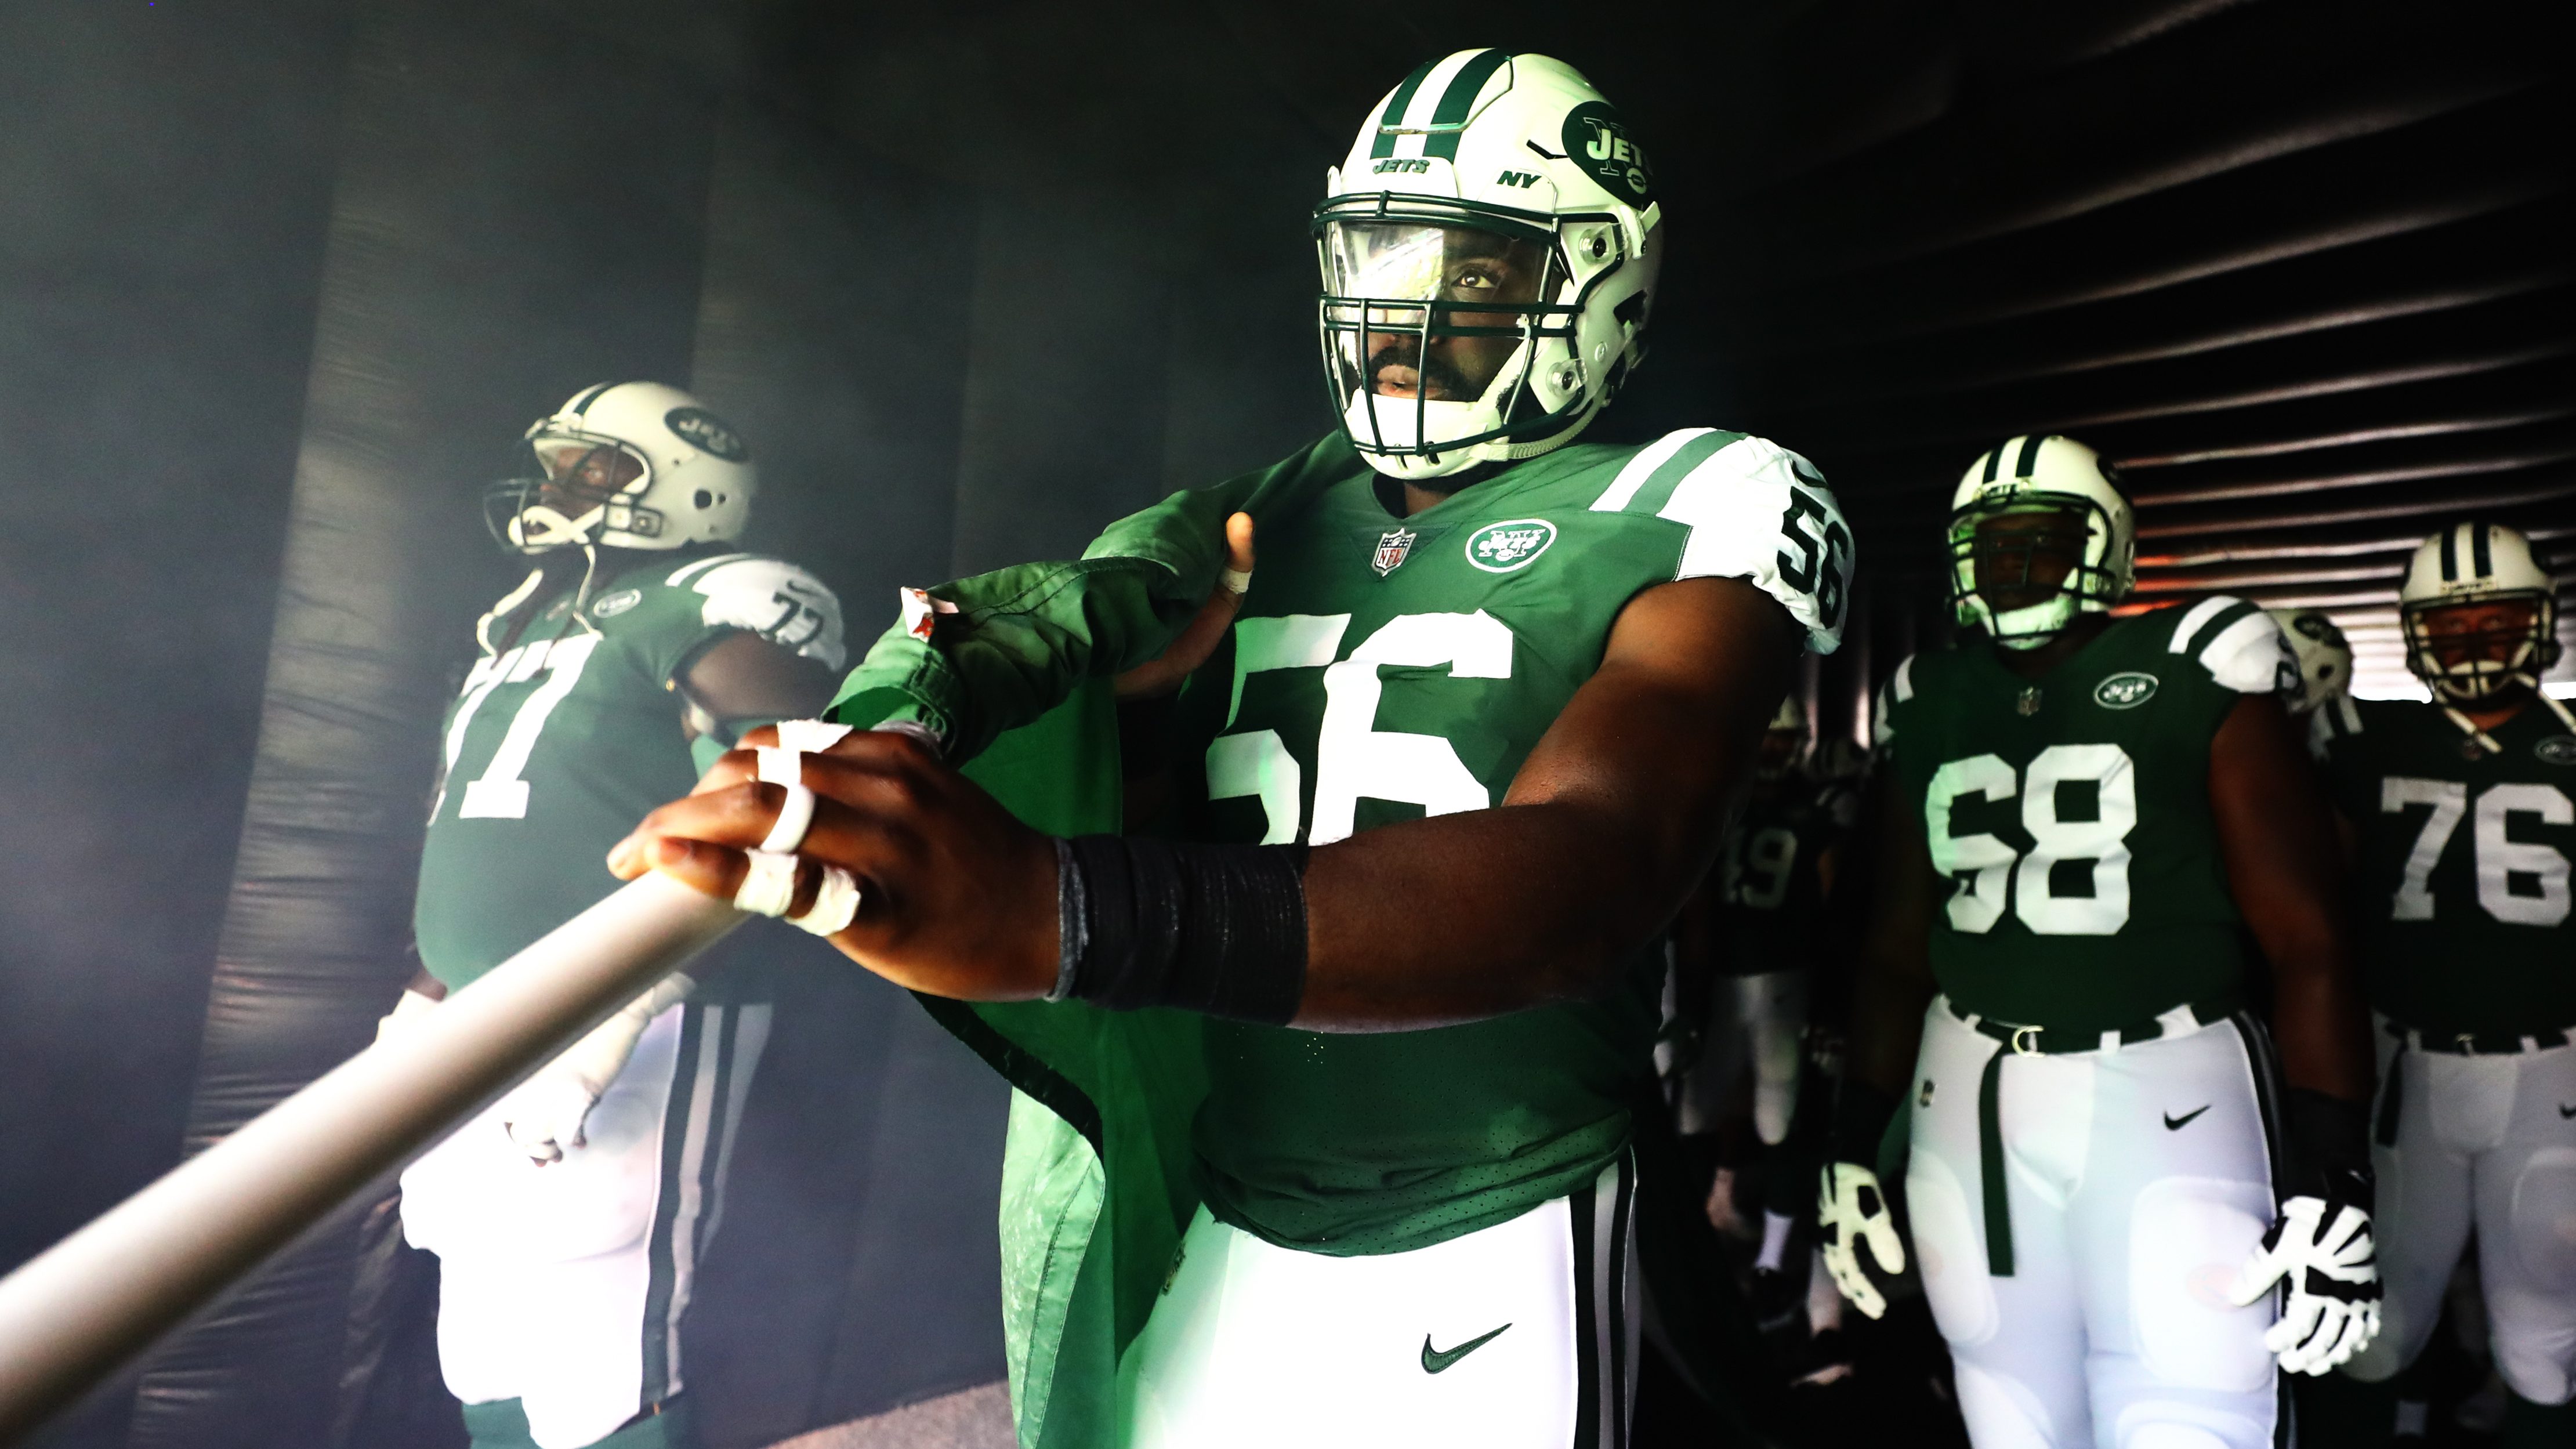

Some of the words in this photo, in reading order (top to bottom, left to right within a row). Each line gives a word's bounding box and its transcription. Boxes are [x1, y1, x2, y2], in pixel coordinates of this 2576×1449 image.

[1373, 159, 1430, 175] JETS
[1497, 171, 1542, 189] NY
[759, 591, 824, 647] 77
[1378, 548, 1403, 567] NFL
[1777, 486, 1848, 629] 56
[427, 631, 603, 826] 77
[1205, 608, 1513, 847] 56
[1925, 743, 2137, 936] 68
[2380, 776, 2574, 927] 76
